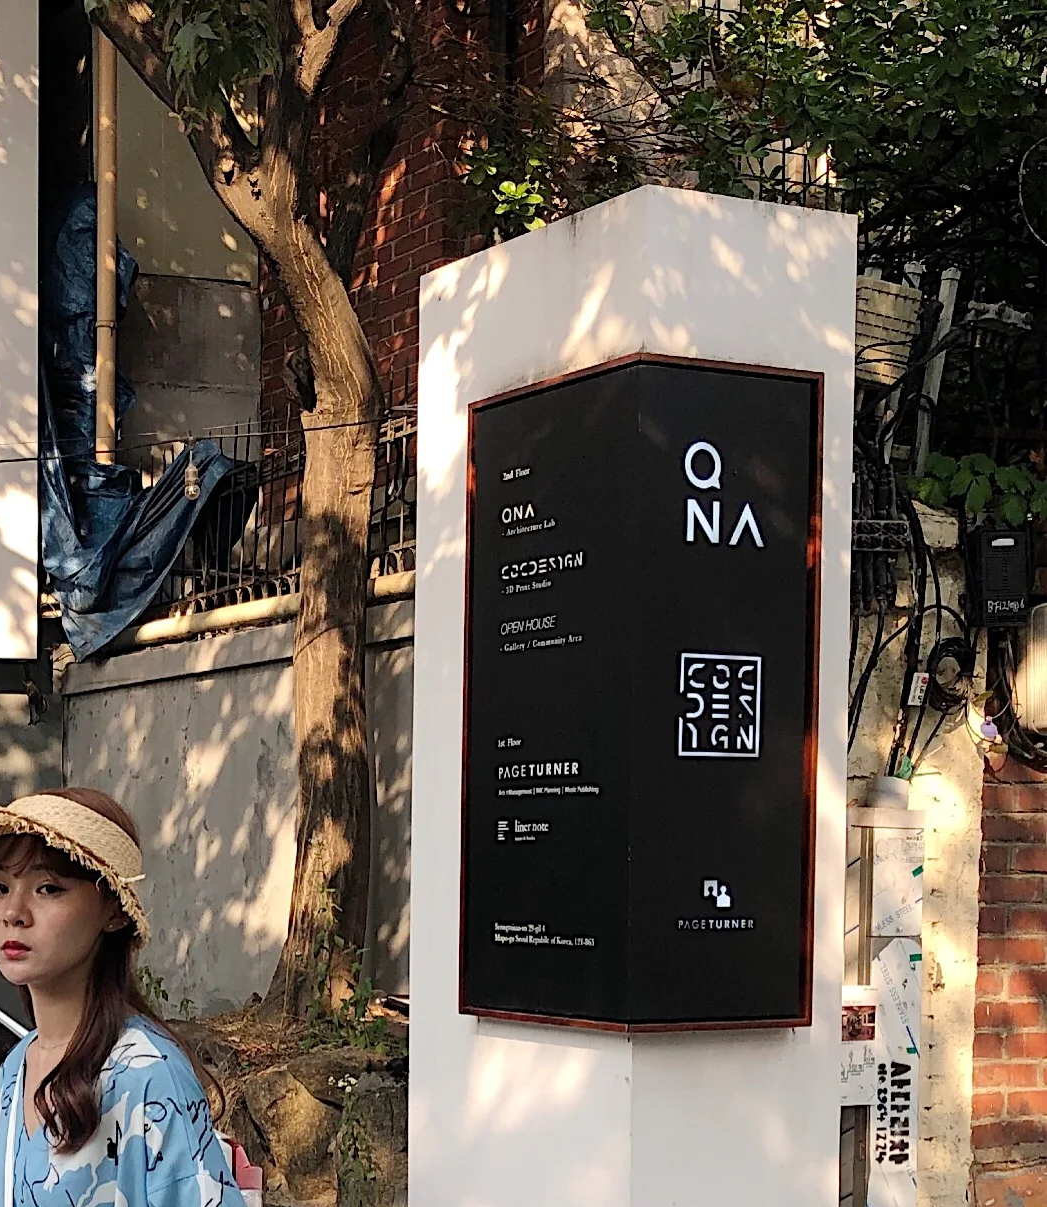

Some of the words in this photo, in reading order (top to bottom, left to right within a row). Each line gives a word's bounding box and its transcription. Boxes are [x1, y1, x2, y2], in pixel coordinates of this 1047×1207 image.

[502, 470, 514, 480] 2nd
[515, 468, 531, 478] Floor
[684, 441, 722, 490] Q
[501, 503, 535, 524] QNA
[506, 523, 543, 536] Architecture
[543, 518, 556, 529] Lab
[532, 579, 552, 590] Studio
[500, 621, 524, 636] OPEN
[525, 615, 557, 631] HOUSE
[504, 642, 525, 652] Gallery
[532, 636, 567, 648] Community
[568, 634, 583, 643] Area
[506, 737, 522, 747] Floor
[532, 822, 549, 832] note
[515, 934, 528, 943] Seoul
[875, 1127, 888, 1164] 1224
